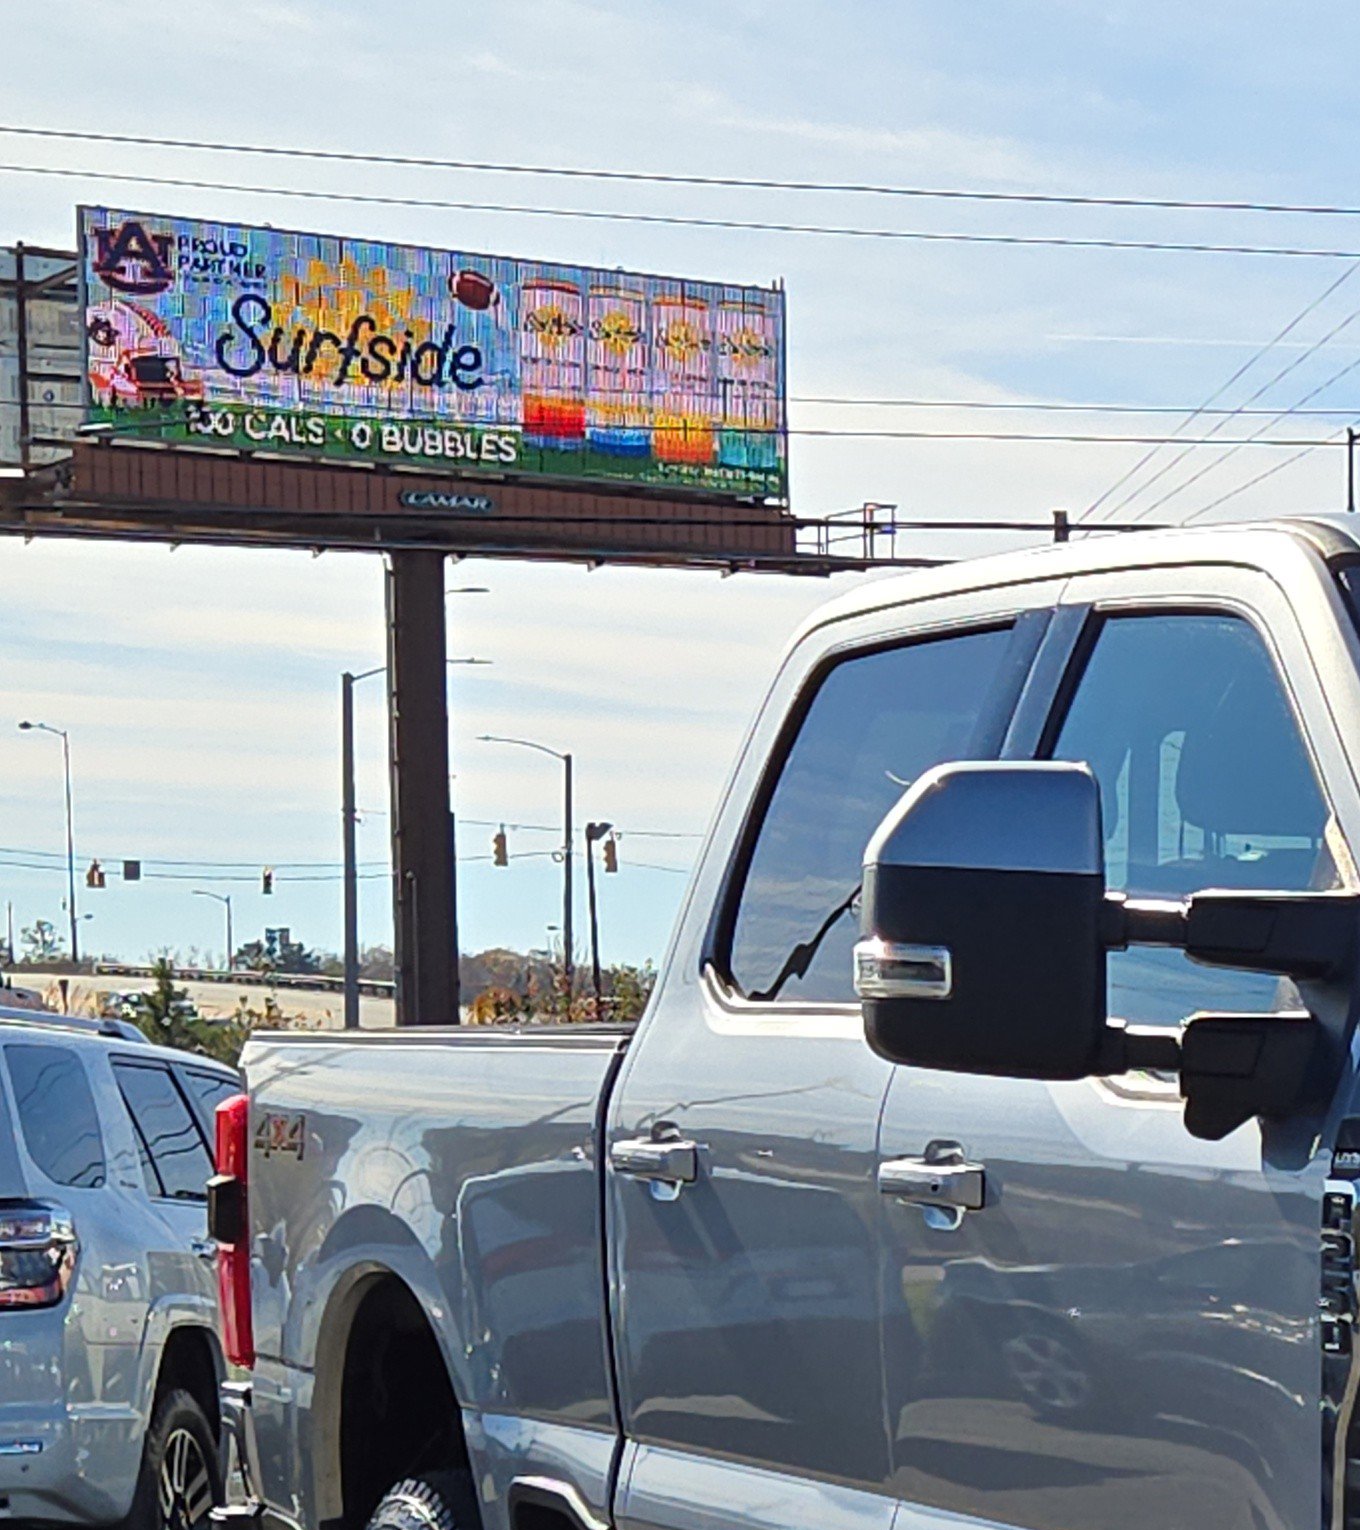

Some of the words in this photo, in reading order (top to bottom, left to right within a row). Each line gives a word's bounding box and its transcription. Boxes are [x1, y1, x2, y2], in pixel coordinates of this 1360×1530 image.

[215, 293, 484, 390] Surfside
[245, 412, 326, 445] CALS
[351, 422, 372, 450] 0
[381, 424, 518, 463] BUBBLES
